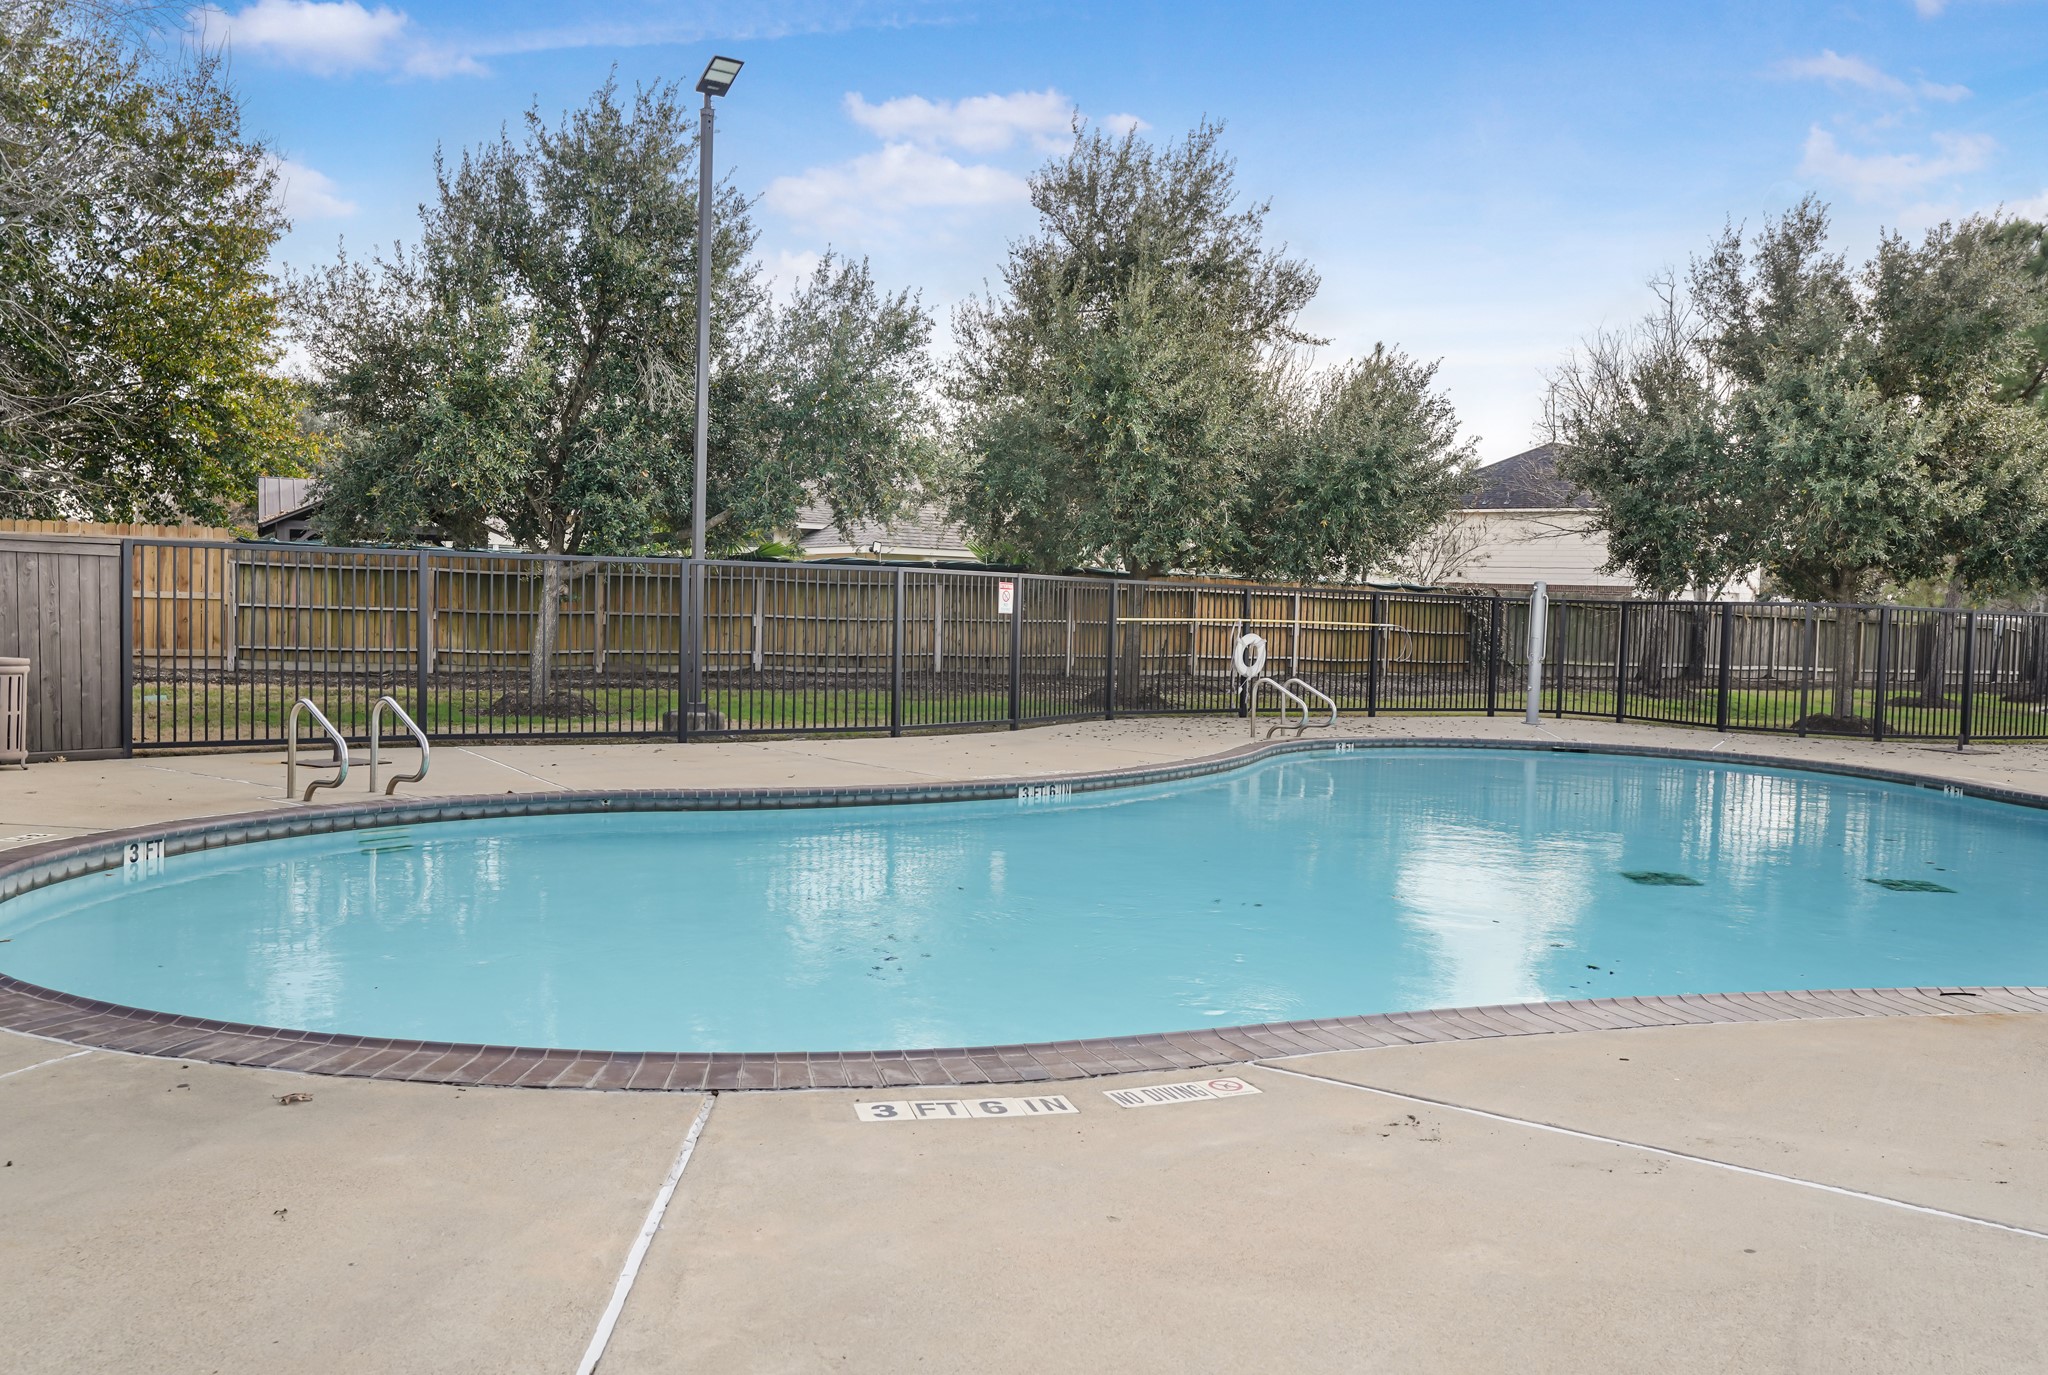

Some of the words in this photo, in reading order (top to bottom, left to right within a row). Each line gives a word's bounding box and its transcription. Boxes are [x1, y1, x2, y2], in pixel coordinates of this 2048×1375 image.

[1022, 786, 1029, 798] 3
[1033, 785, 1045, 797] FT
[1049, 784, 1056, 796] 6
[1060, 783, 1070, 795] IN
[129, 843, 139, 863] 3
[145, 838, 163, 861] FT
[1110, 1091, 1145, 1105] NO
[1140, 1084, 1209, 1102] DIVING
[871, 1104, 898, 1118] 3
[914, 1102, 958, 1117] FT
[978, 1100, 1008, 1114] 6
[1023, 1097, 1068, 1113] IN
